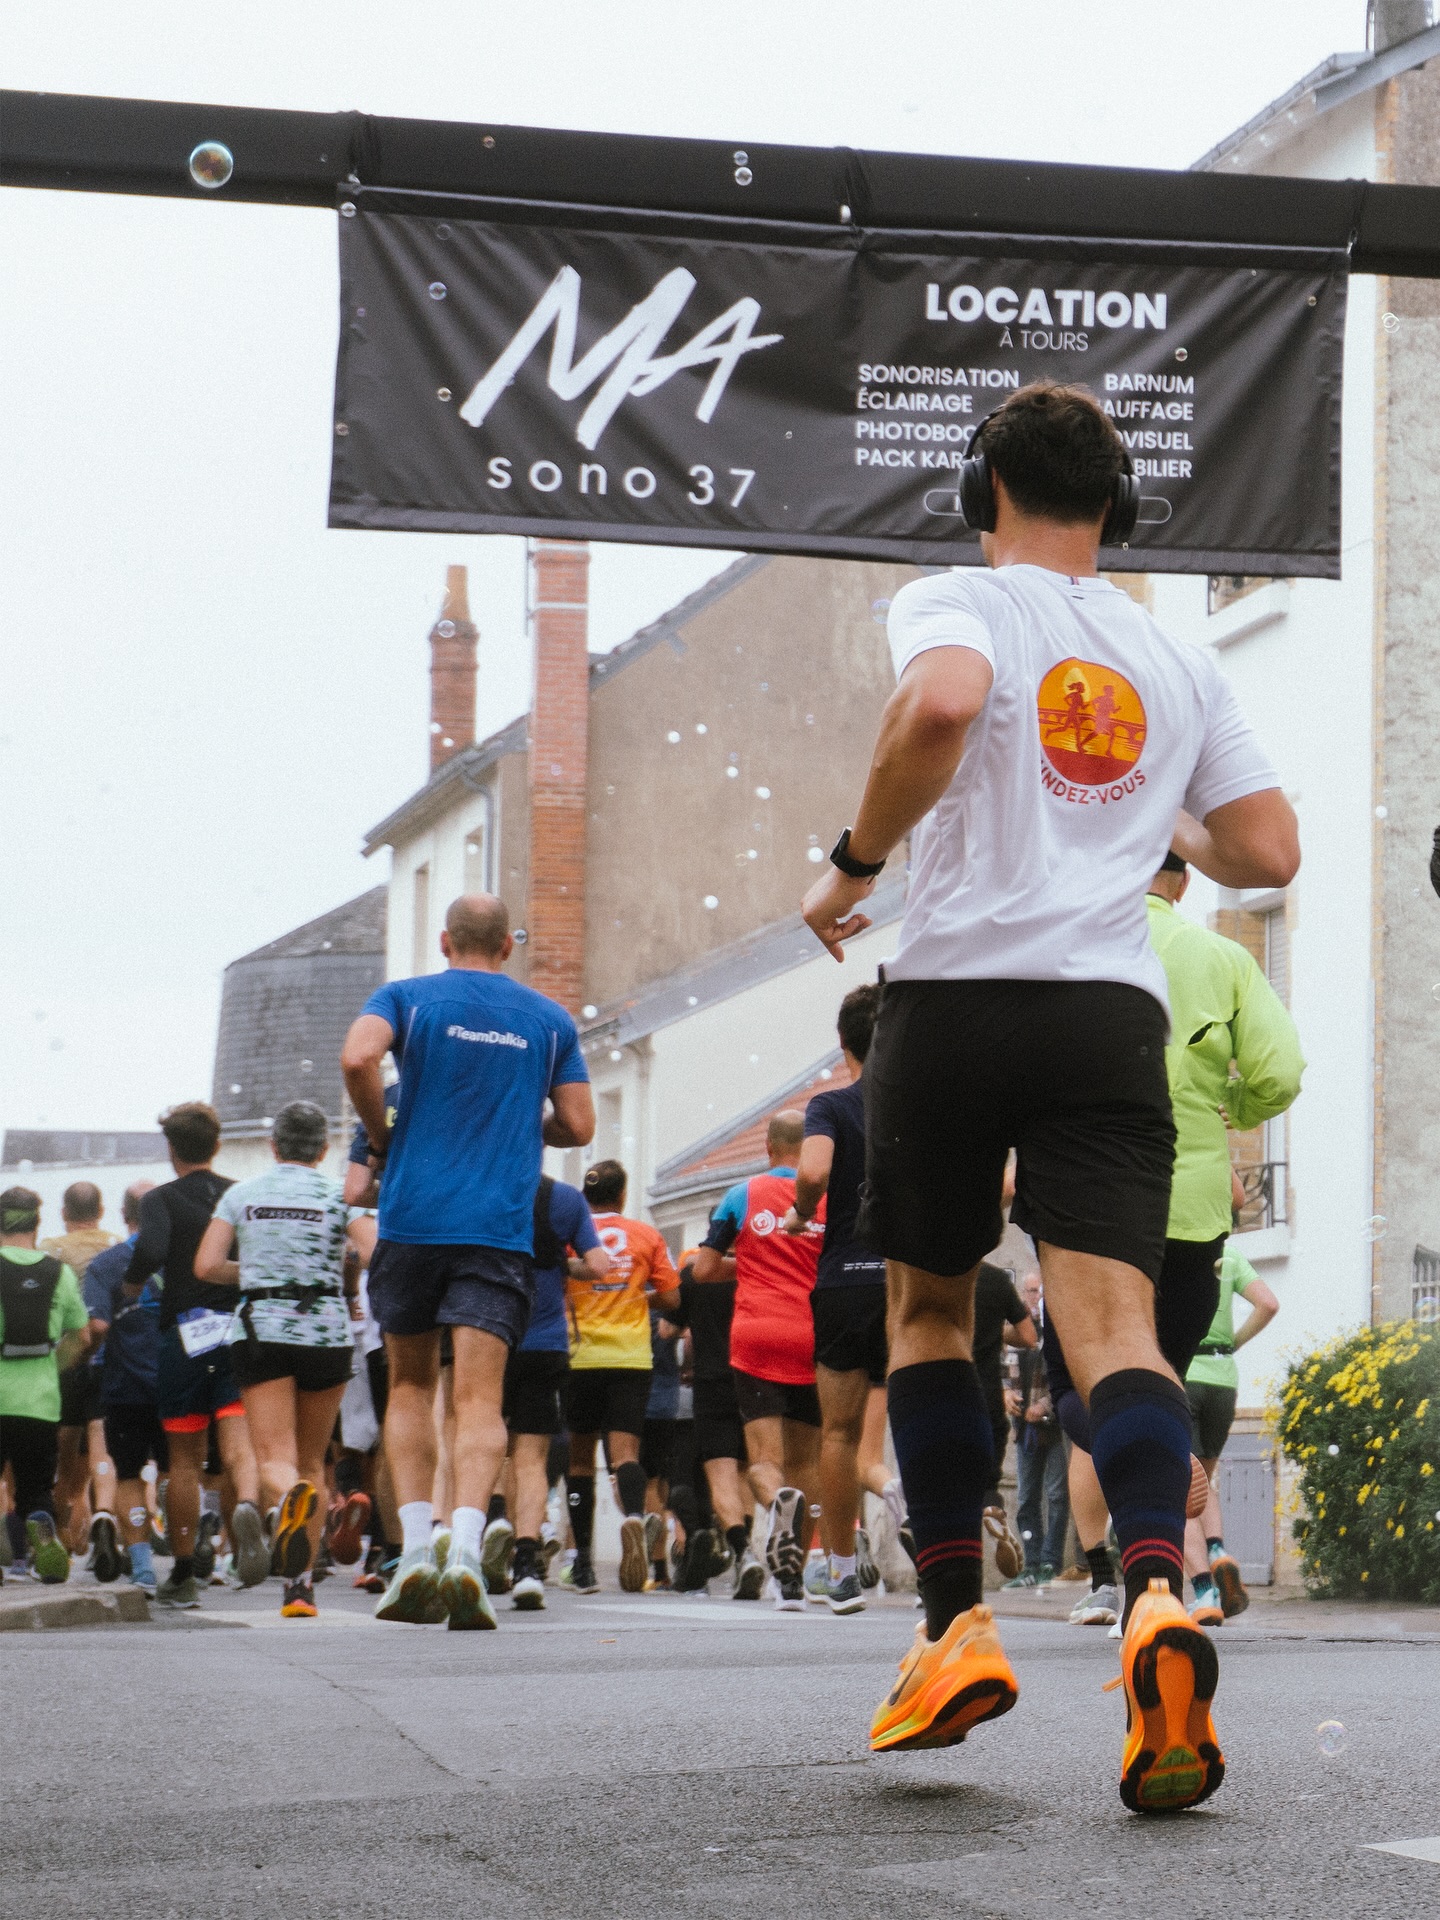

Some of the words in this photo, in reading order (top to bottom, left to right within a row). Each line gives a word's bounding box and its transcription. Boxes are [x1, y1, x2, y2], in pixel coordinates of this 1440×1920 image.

[926, 283, 1168, 331] LOCATION
[999, 326, 1014, 348] À
[1021, 330, 1089, 352] TOURS
[858, 364, 1020, 388] SONORISATION
[1104, 372, 1194, 395] BARNUM
[857, 387, 973, 413] ÉCLAIRAGE
[1098, 398, 1194, 421] AUFFAGE
[1114, 430, 1194, 451] VISUEL
[855, 447, 916, 468] PACK
[921, 450, 963, 469] KAR
[1133, 457, 1193, 478] BILIER
[486, 456, 657, 499] sono
[687, 463, 756, 508] 37
[1041, 766, 1146, 804] NDEZ-VOUS
[446, 1024, 528, 1049] #TeamDalkia
